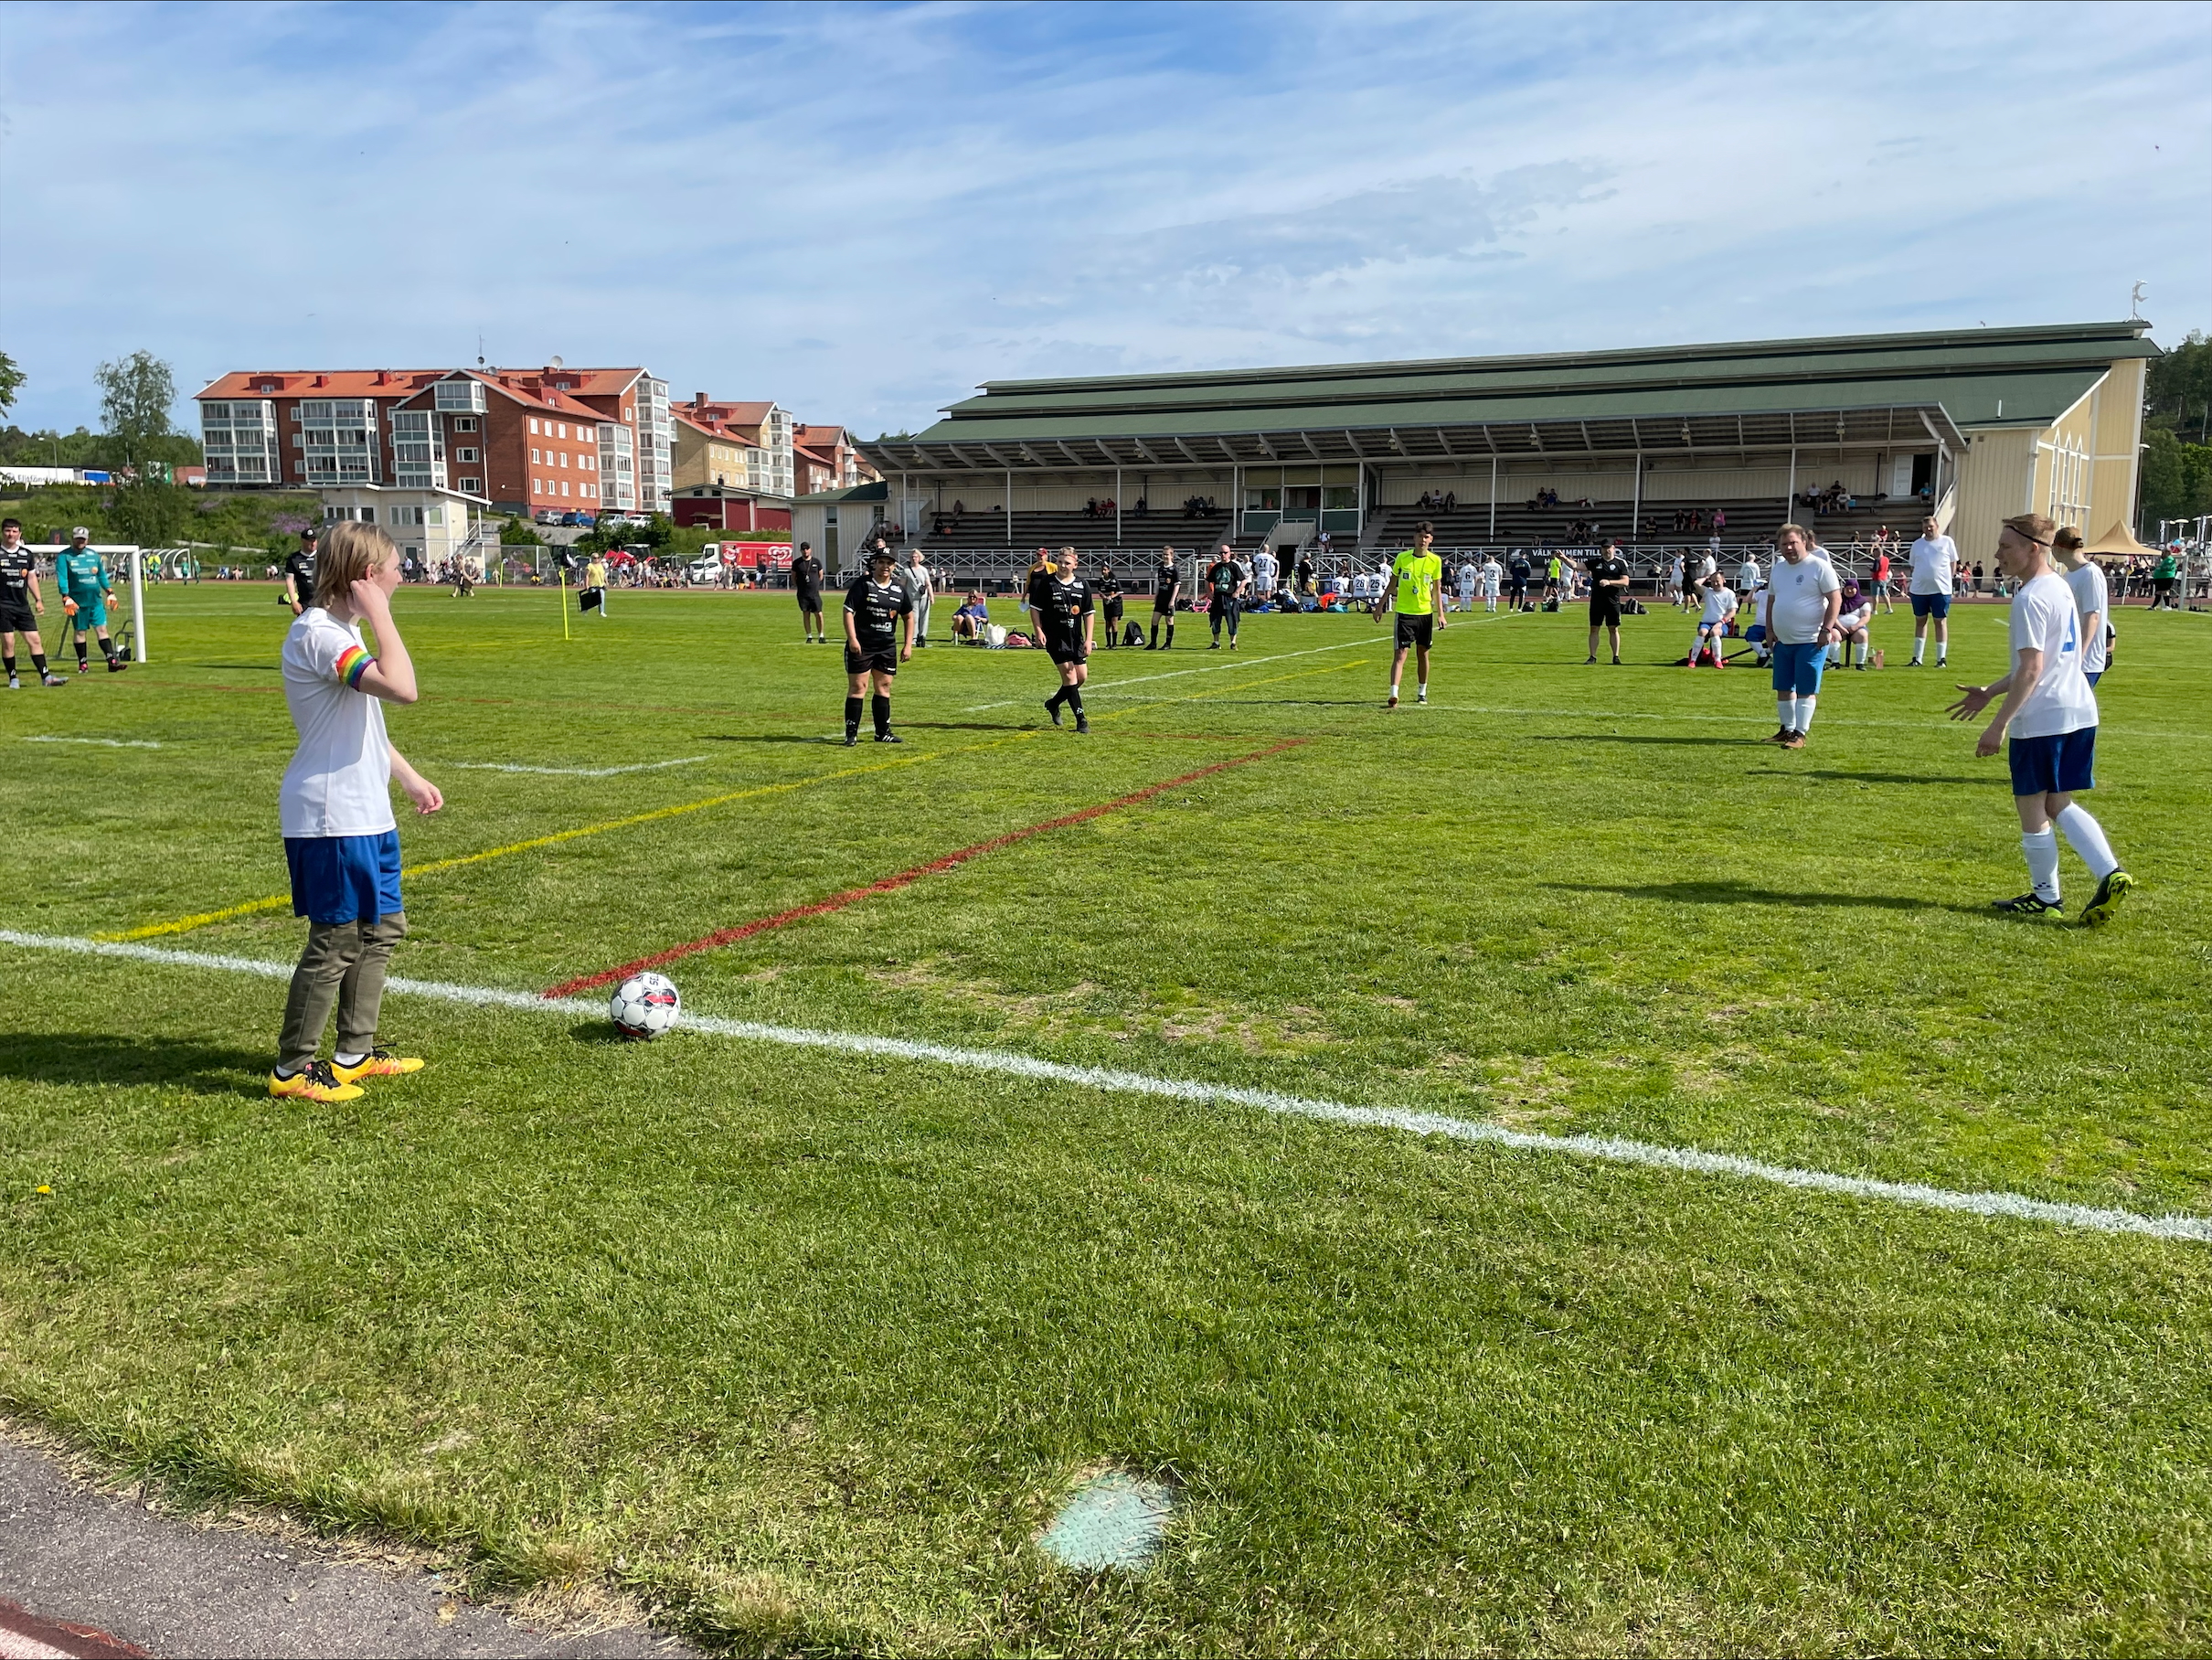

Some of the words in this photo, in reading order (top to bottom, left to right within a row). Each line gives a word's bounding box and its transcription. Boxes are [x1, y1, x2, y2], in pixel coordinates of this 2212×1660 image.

[1531, 548, 1583, 557] VÄLKMMEN
[1584, 548, 1601, 557] TILL
[1258, 558, 1269, 568] 27
[1465, 571, 1471, 580] 6
[1489, 569, 1495, 578] 3
[1333, 581, 1341, 591] 12
[1356, 579, 1365, 588] 28
[1370, 579, 1380, 589] 25
